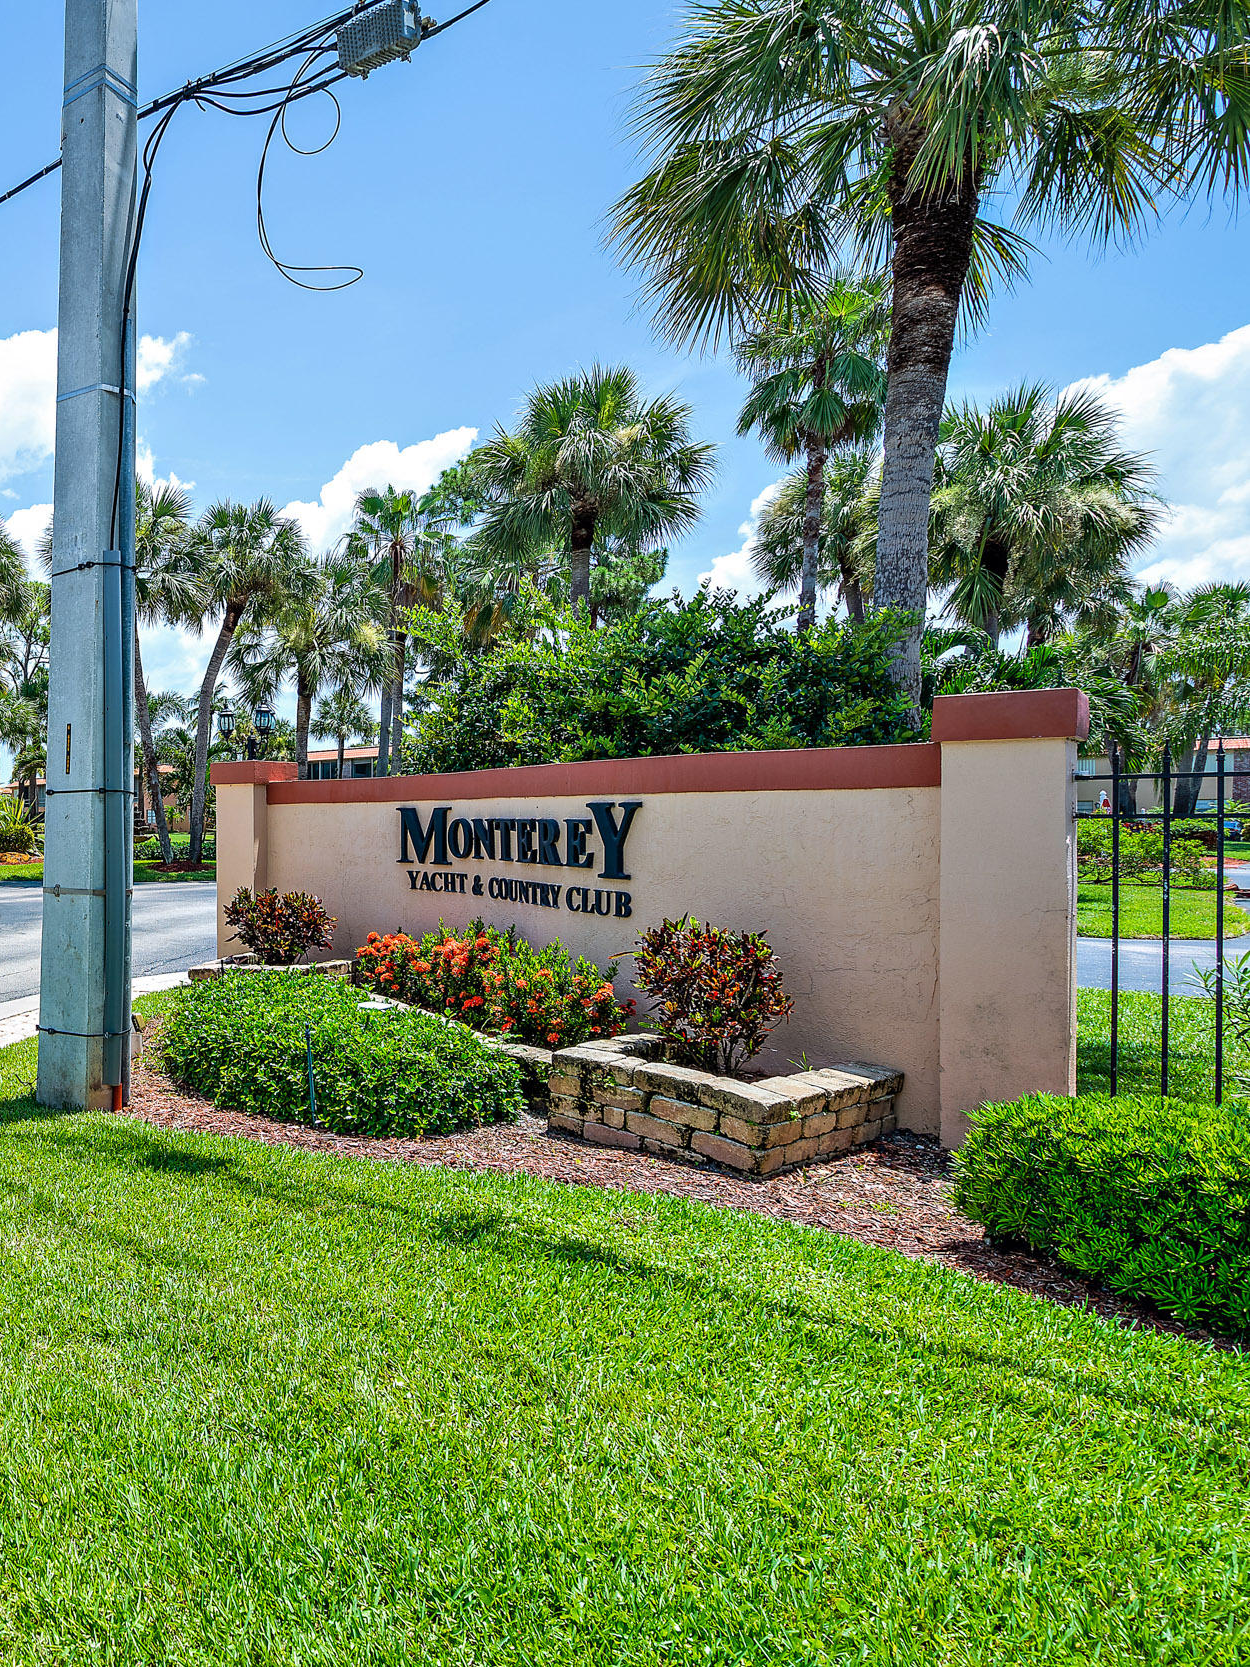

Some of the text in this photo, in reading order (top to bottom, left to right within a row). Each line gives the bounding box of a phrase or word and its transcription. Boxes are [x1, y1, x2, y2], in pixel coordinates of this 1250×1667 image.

[396, 801, 643, 880] MONTEREY
[406, 870, 633, 918] YACHT & COUNTRY CLUB
